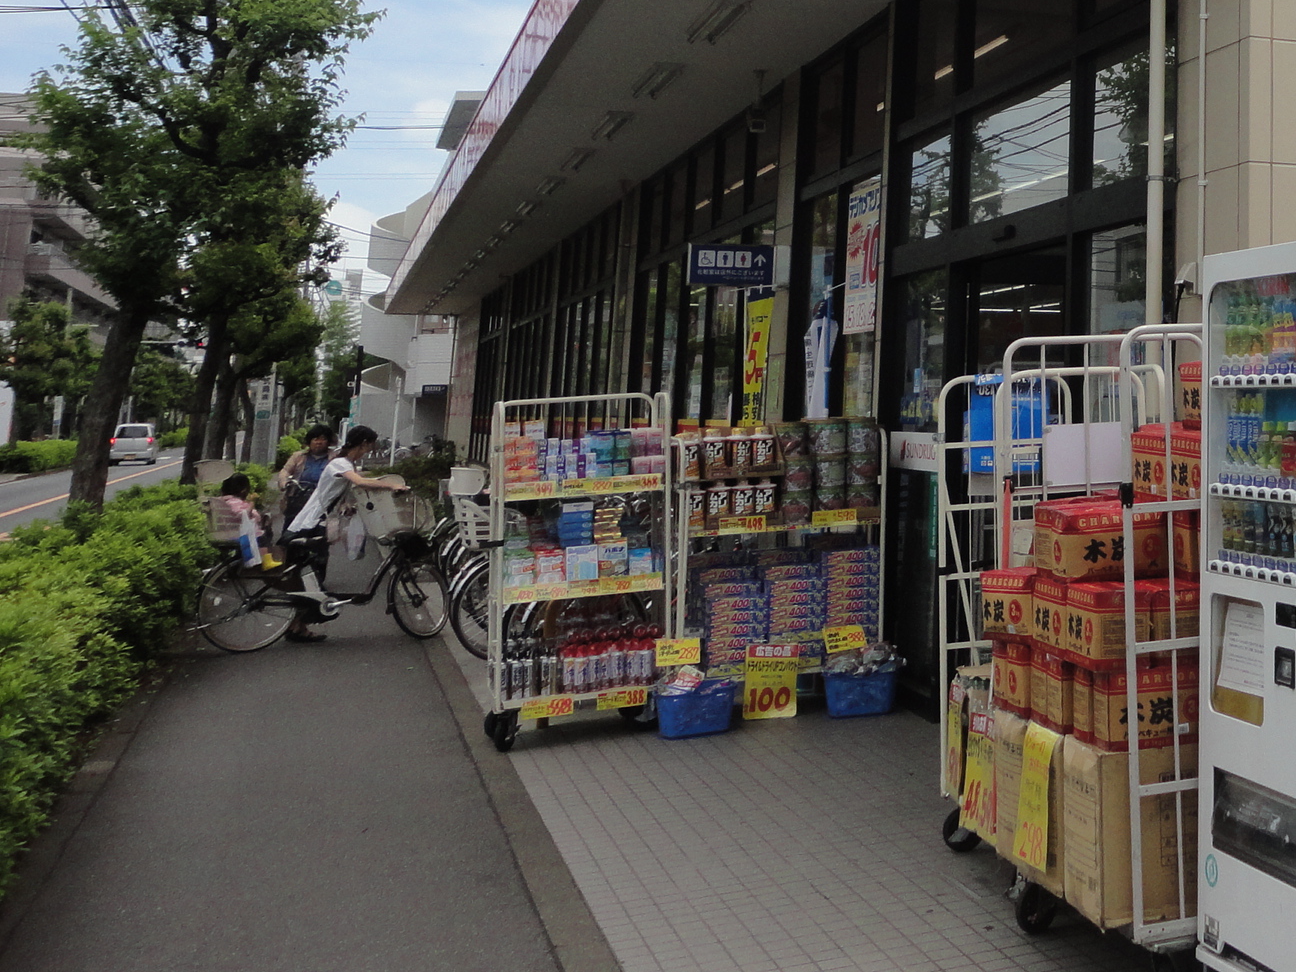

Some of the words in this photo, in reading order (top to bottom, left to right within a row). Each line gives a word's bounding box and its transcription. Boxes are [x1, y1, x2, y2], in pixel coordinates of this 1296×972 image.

[1180, 366, 1201, 375] CHARC
[1171, 439, 1201, 451] HARCOA
[906, 442, 936, 460] SUNDRUG
[1135, 458, 1151, 483] 木炭
[1079, 512, 1161, 527] CHAROAL
[846, 552, 864, 561] 400
[784, 567, 802, 576] 400
[846, 564, 864, 573] 400
[789, 581, 808, 590] 400
[846, 577, 864, 586] 400
[982, 577, 1023, 587] CHARCOAL
[724, 584, 743, 594] 400
[845, 589, 864, 598] 400
[731, 599, 750, 608] 400
[789, 594, 808, 603] 400
[845, 601, 863, 610] 400
[984, 599, 1005, 622] 木炭
[730, 612, 749, 621] 400
[789, 607, 807, 616] 400
[1035, 604, 1050, 632] 木炭
[730, 625, 749, 634] 400
[789, 620, 807, 629] 400
[1068, 612, 1083, 641] 木炭
[727, 638, 745, 648] 400
[679, 647, 699, 660] 287
[755, 646, 791, 657] 広告の品
[1118, 671, 1196, 685] CARCOA
[626, 689, 645, 704] 388
[749, 686, 791, 713] 100
